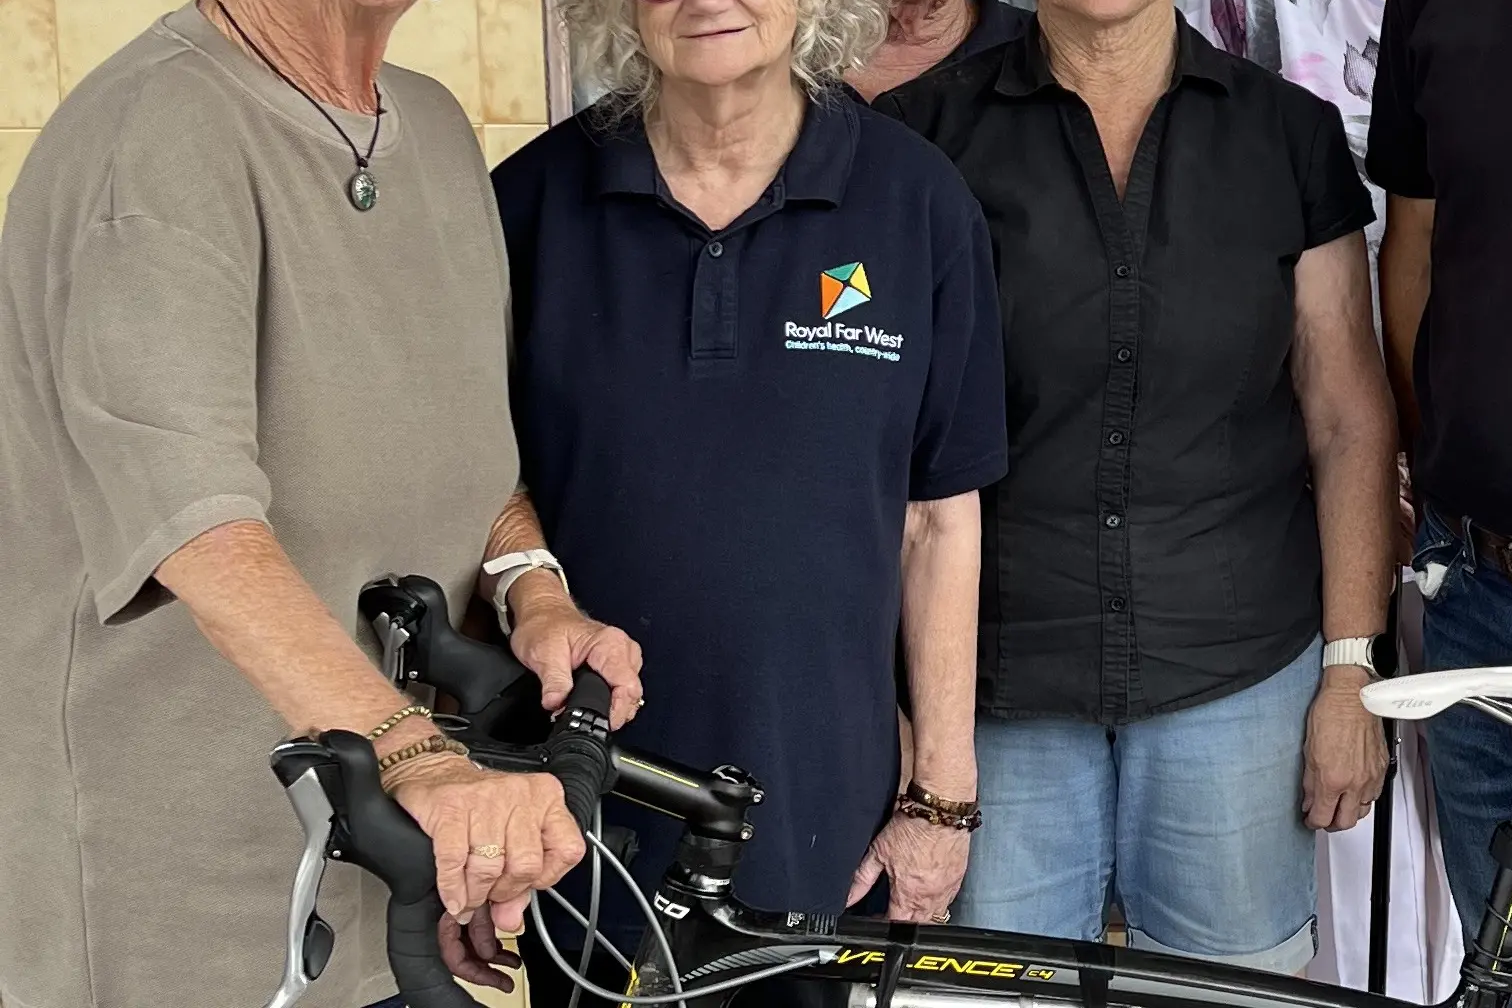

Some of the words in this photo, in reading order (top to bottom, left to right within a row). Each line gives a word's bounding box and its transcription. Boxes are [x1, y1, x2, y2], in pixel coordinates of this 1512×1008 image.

[784, 320, 832, 342] Royal
[835, 322, 864, 341] Far
[864, 325, 904, 349] West
[784, 339, 826, 352] Children's
